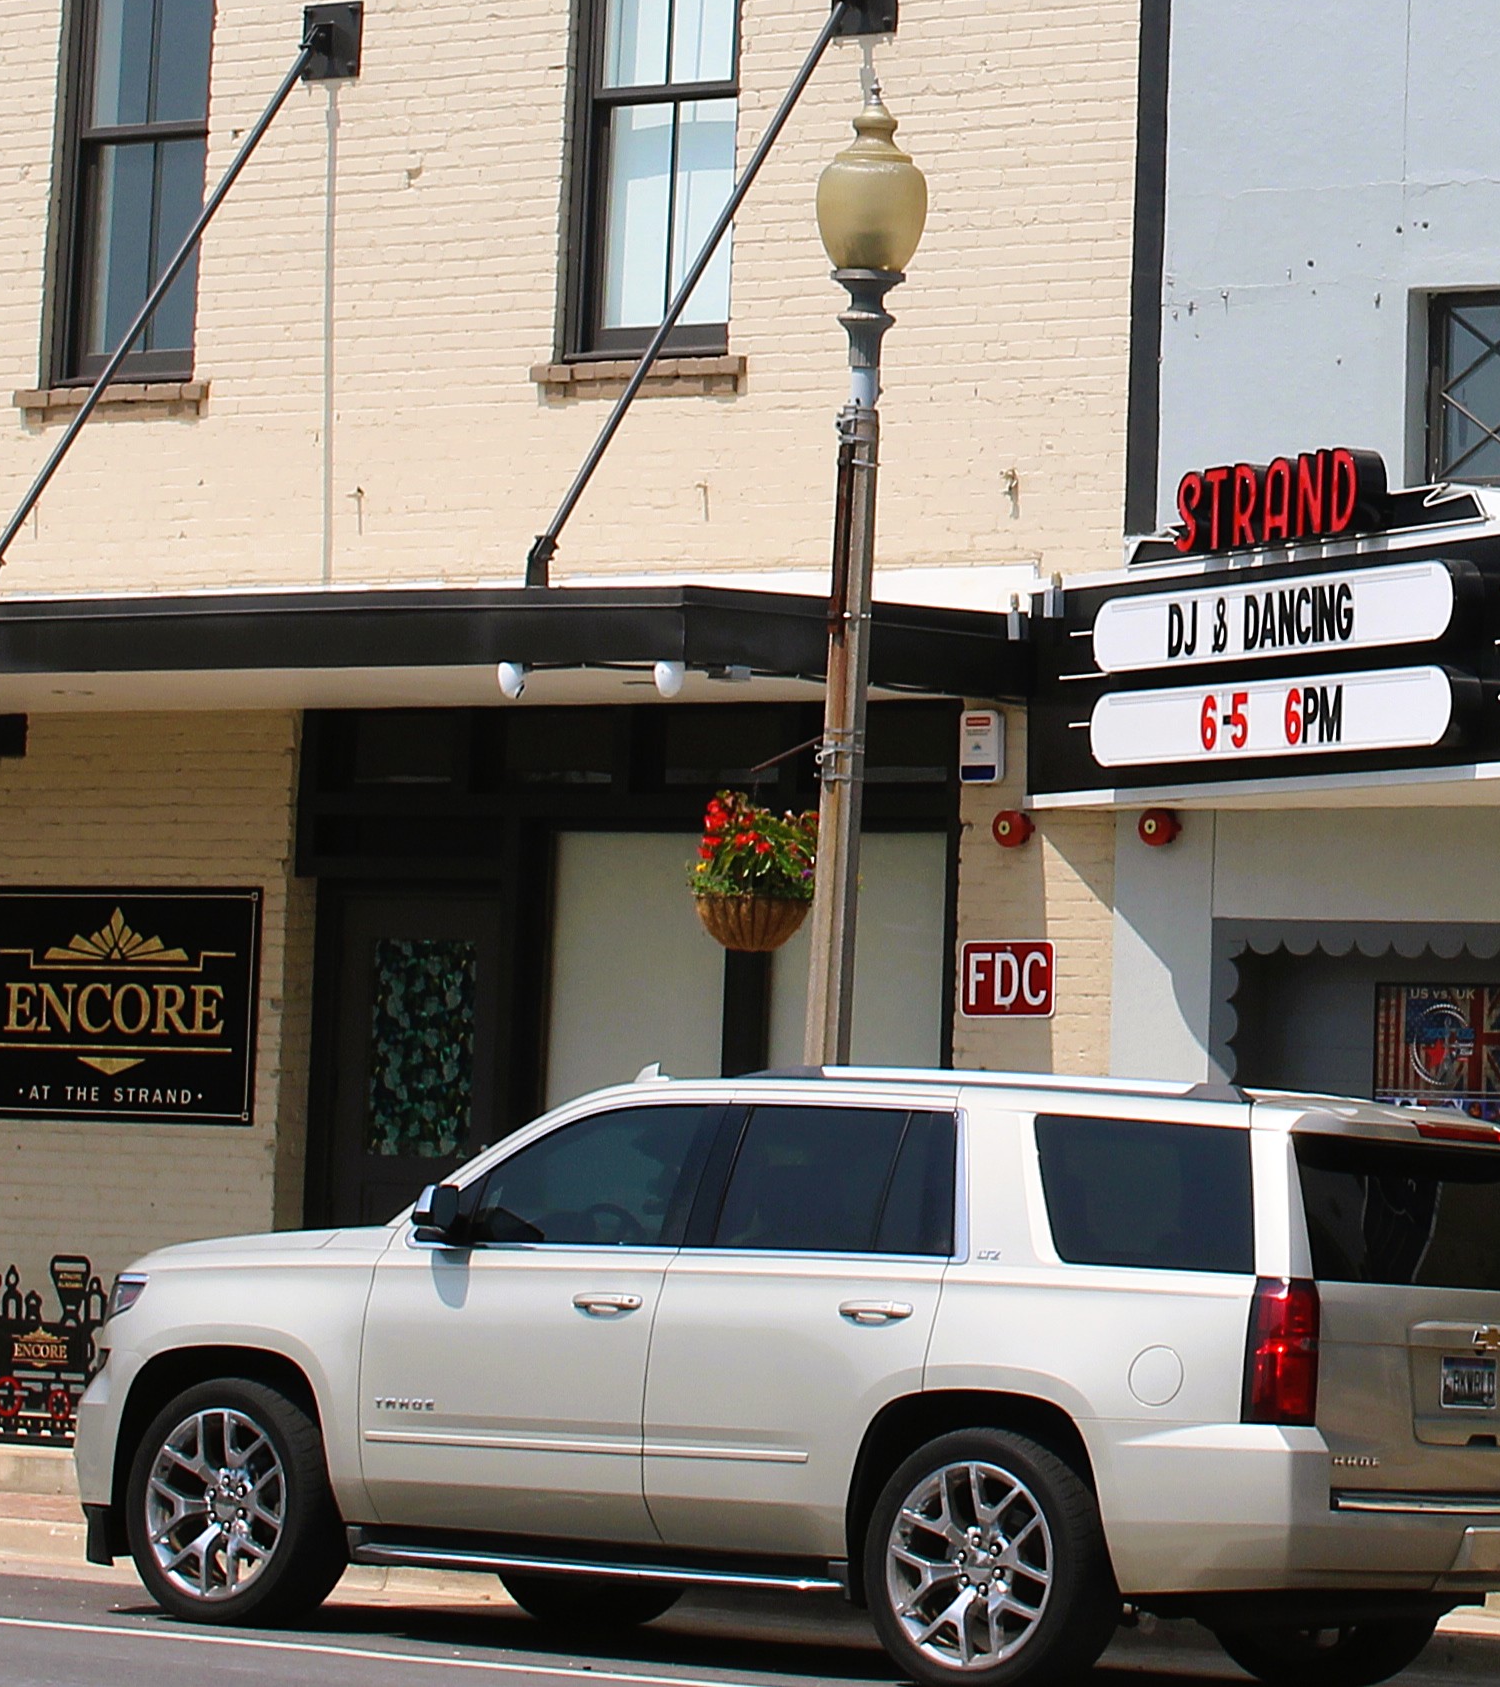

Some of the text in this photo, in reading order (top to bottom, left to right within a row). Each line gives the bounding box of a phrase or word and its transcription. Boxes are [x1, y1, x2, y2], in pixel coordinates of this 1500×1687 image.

[1175, 448, 1357, 553] STRAND
[1168, 583, 1353, 658] DJ & DANCING
[1200, 685, 1343, 750] 6-5 6PM
[968, 949, 1047, 1006] FDC
[1410, 988, 1429, 1000] US
[1456, 988, 1476, 1000] UK
[3, 982, 224, 1035] ENCORE
[29, 1085, 192, 1104] AT THE STRAND
[13, 1343, 68, 1359] ENCORE
[374, 1396, 435, 1411] TAHOE
